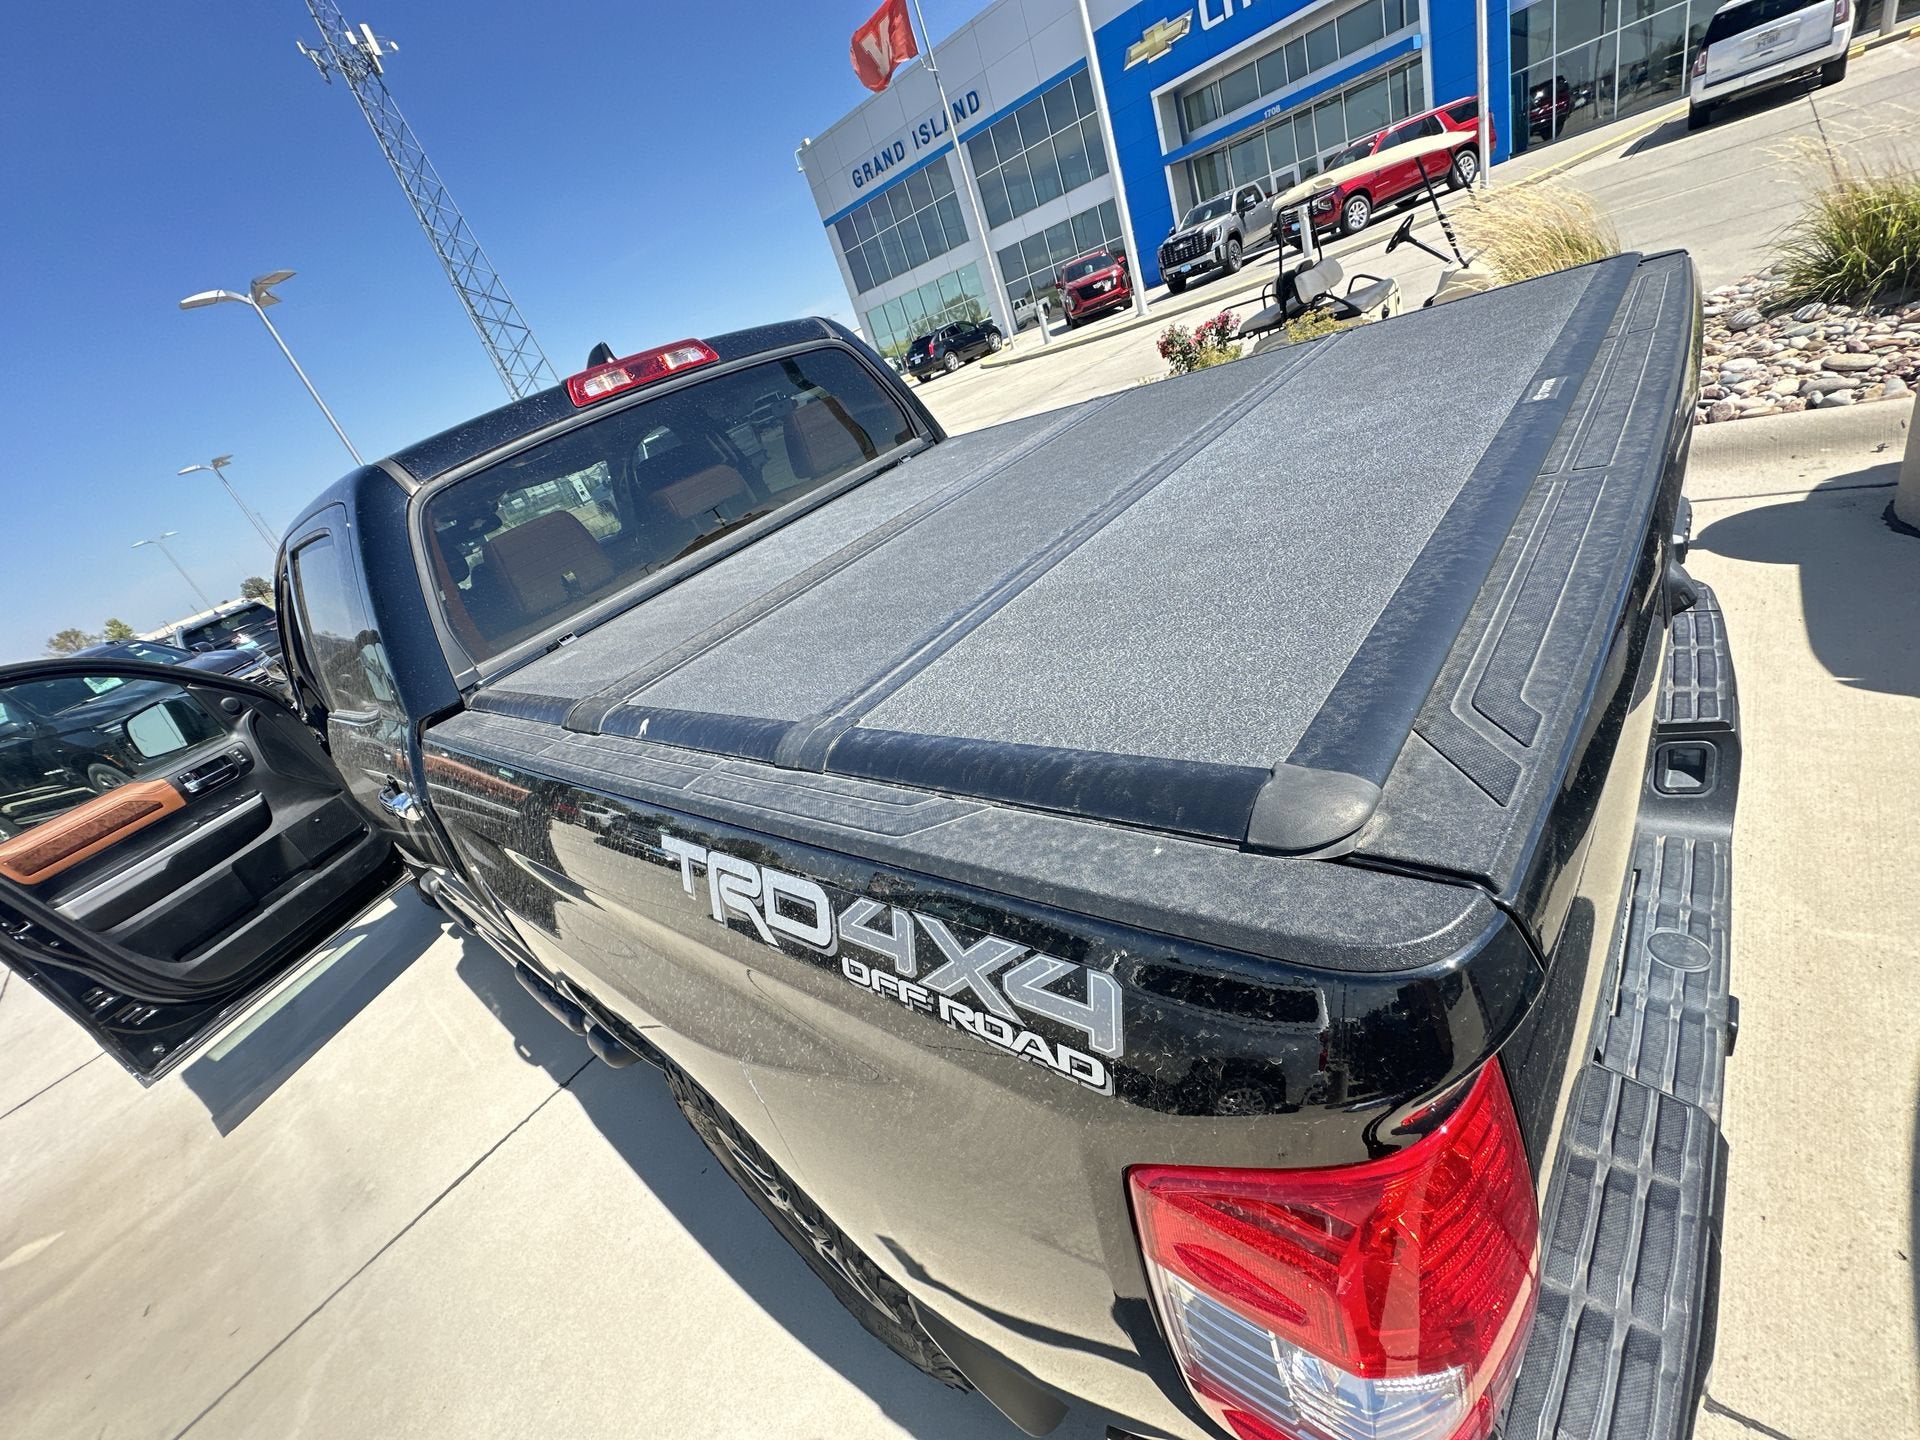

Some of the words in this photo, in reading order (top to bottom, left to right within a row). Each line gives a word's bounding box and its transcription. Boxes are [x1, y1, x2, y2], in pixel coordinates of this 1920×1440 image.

[1263, 104, 1281, 119] 1708
[852, 140, 905, 188] GRAND
[661, 835, 838, 957] TRD
[841, 956, 934, 1012] OFF
[939, 996, 1115, 1096] ROAD
